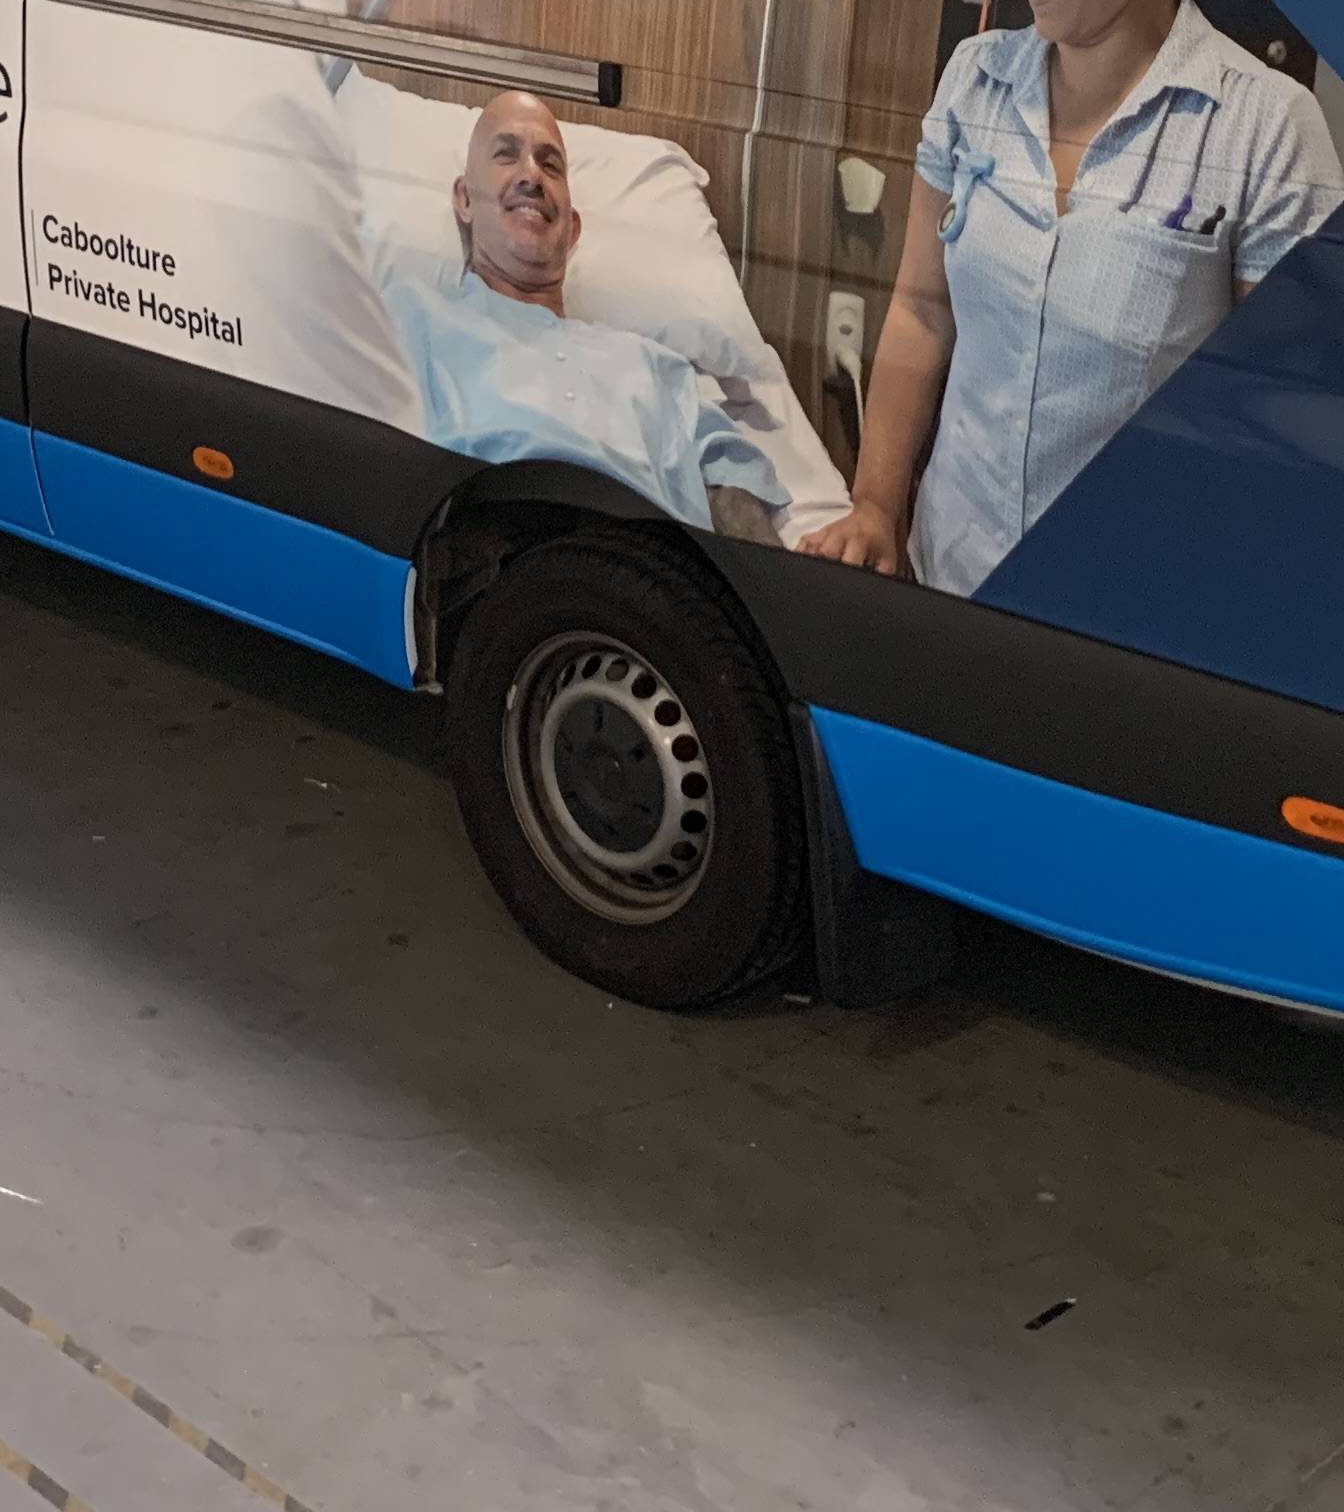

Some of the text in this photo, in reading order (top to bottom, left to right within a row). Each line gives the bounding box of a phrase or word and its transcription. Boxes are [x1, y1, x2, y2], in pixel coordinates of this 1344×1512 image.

[42, 214, 176, 277] Caboolture
[47, 263, 243, 347] Private Hospital
